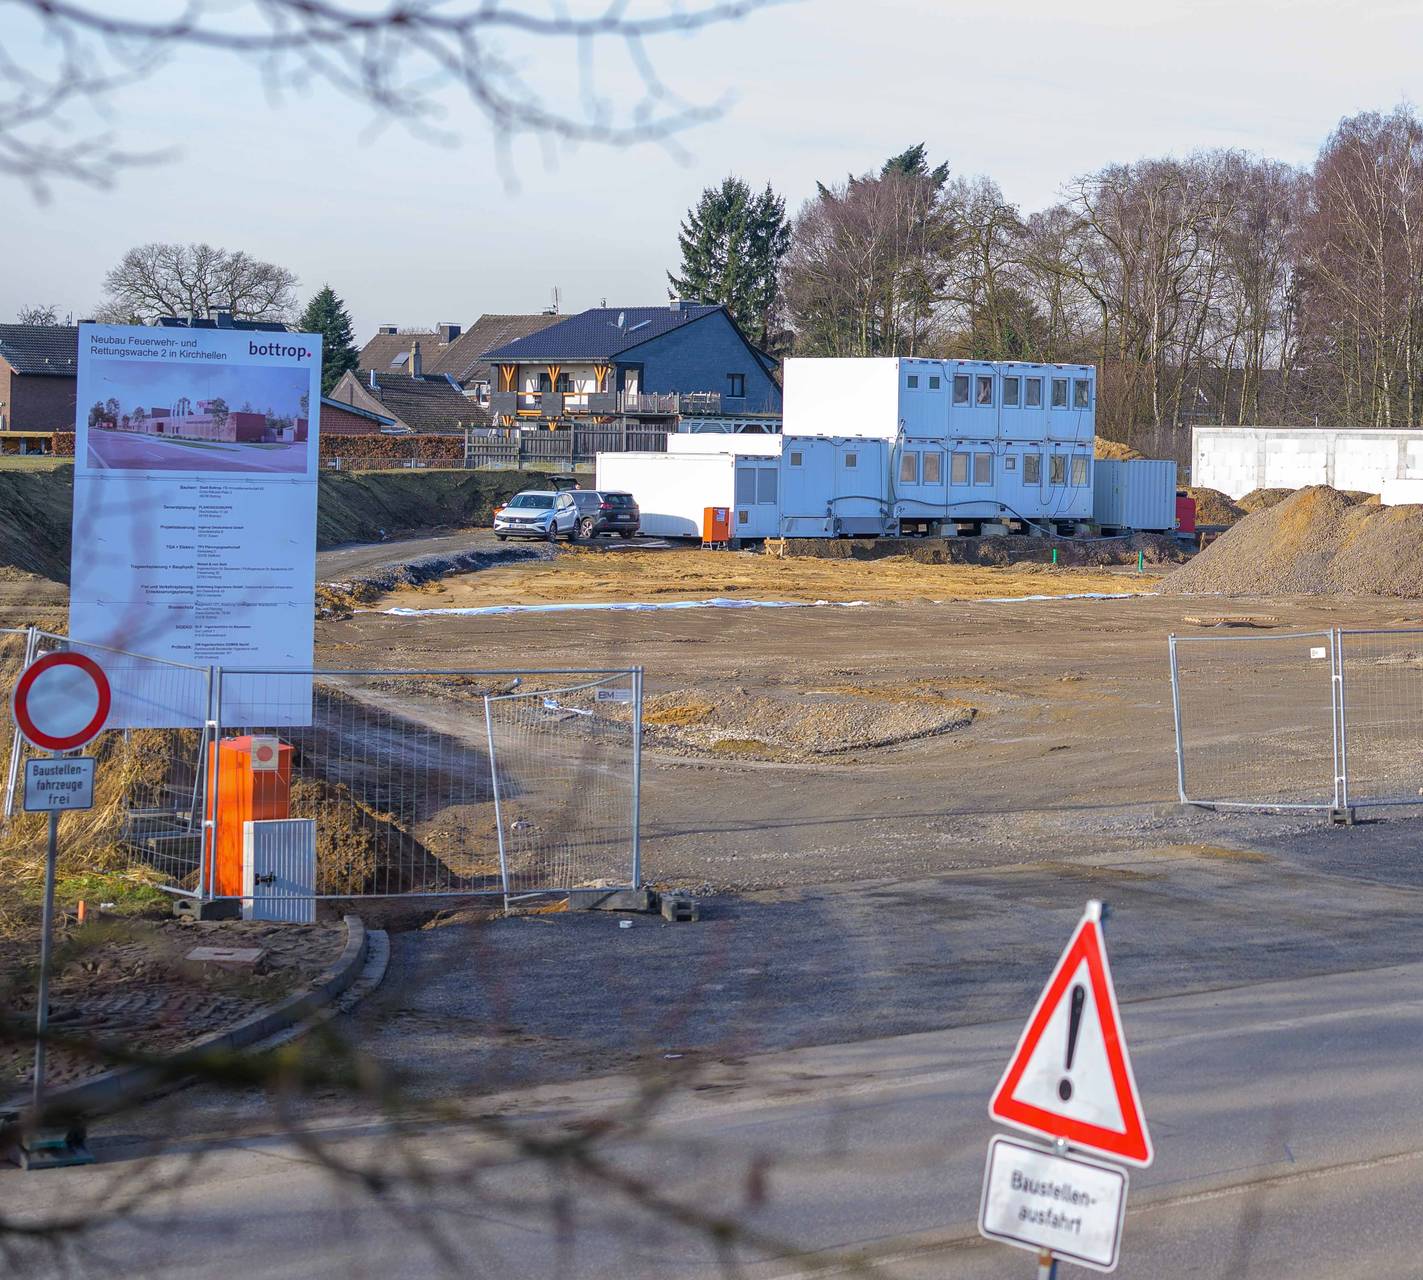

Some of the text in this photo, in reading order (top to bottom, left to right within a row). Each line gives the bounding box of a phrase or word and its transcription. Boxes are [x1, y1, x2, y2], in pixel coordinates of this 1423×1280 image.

[90, 335, 197, 348] Neubau Feuerwehr- und
[90, 346, 227, 360] Rettungswache 2 in Kirchhellen
[249, 341, 312, 361] bottrop.
[32, 764, 87, 776] Baustellen-
[36, 779, 84, 792] fahrzeuge
[48, 792, 71, 805] frei
[1010, 1168, 1098, 1208] Baustellen-
[1018, 1205, 1082, 1235] ausfahrt
